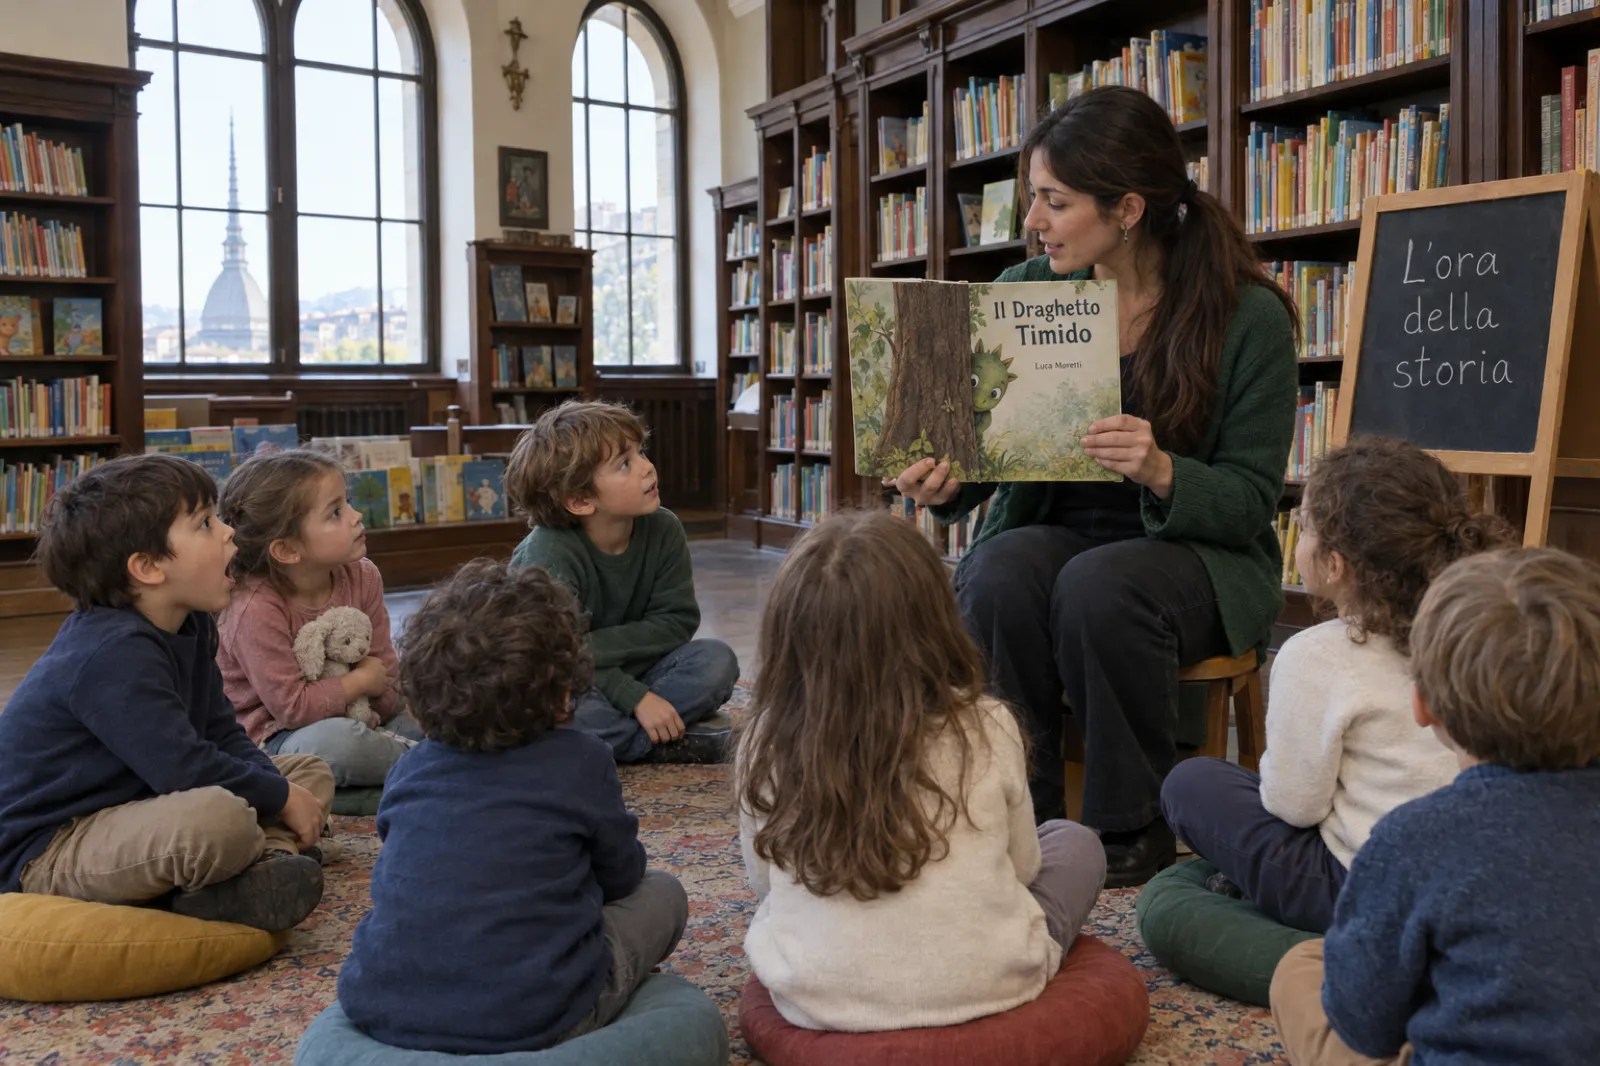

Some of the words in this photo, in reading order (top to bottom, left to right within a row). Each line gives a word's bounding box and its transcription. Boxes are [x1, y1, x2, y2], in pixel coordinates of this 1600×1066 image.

[1402, 238, 1499, 284] L'ora
[994, 300, 1006, 319] Il
[1012, 298, 1100, 322] Draghetto
[1403, 291, 1500, 335] della
[1015, 322, 1092, 346] Timido
[1035, 362, 1053, 370] Luca
[1054, 361, 1082, 370] Moretti
[1392, 346, 1513, 389] storia
